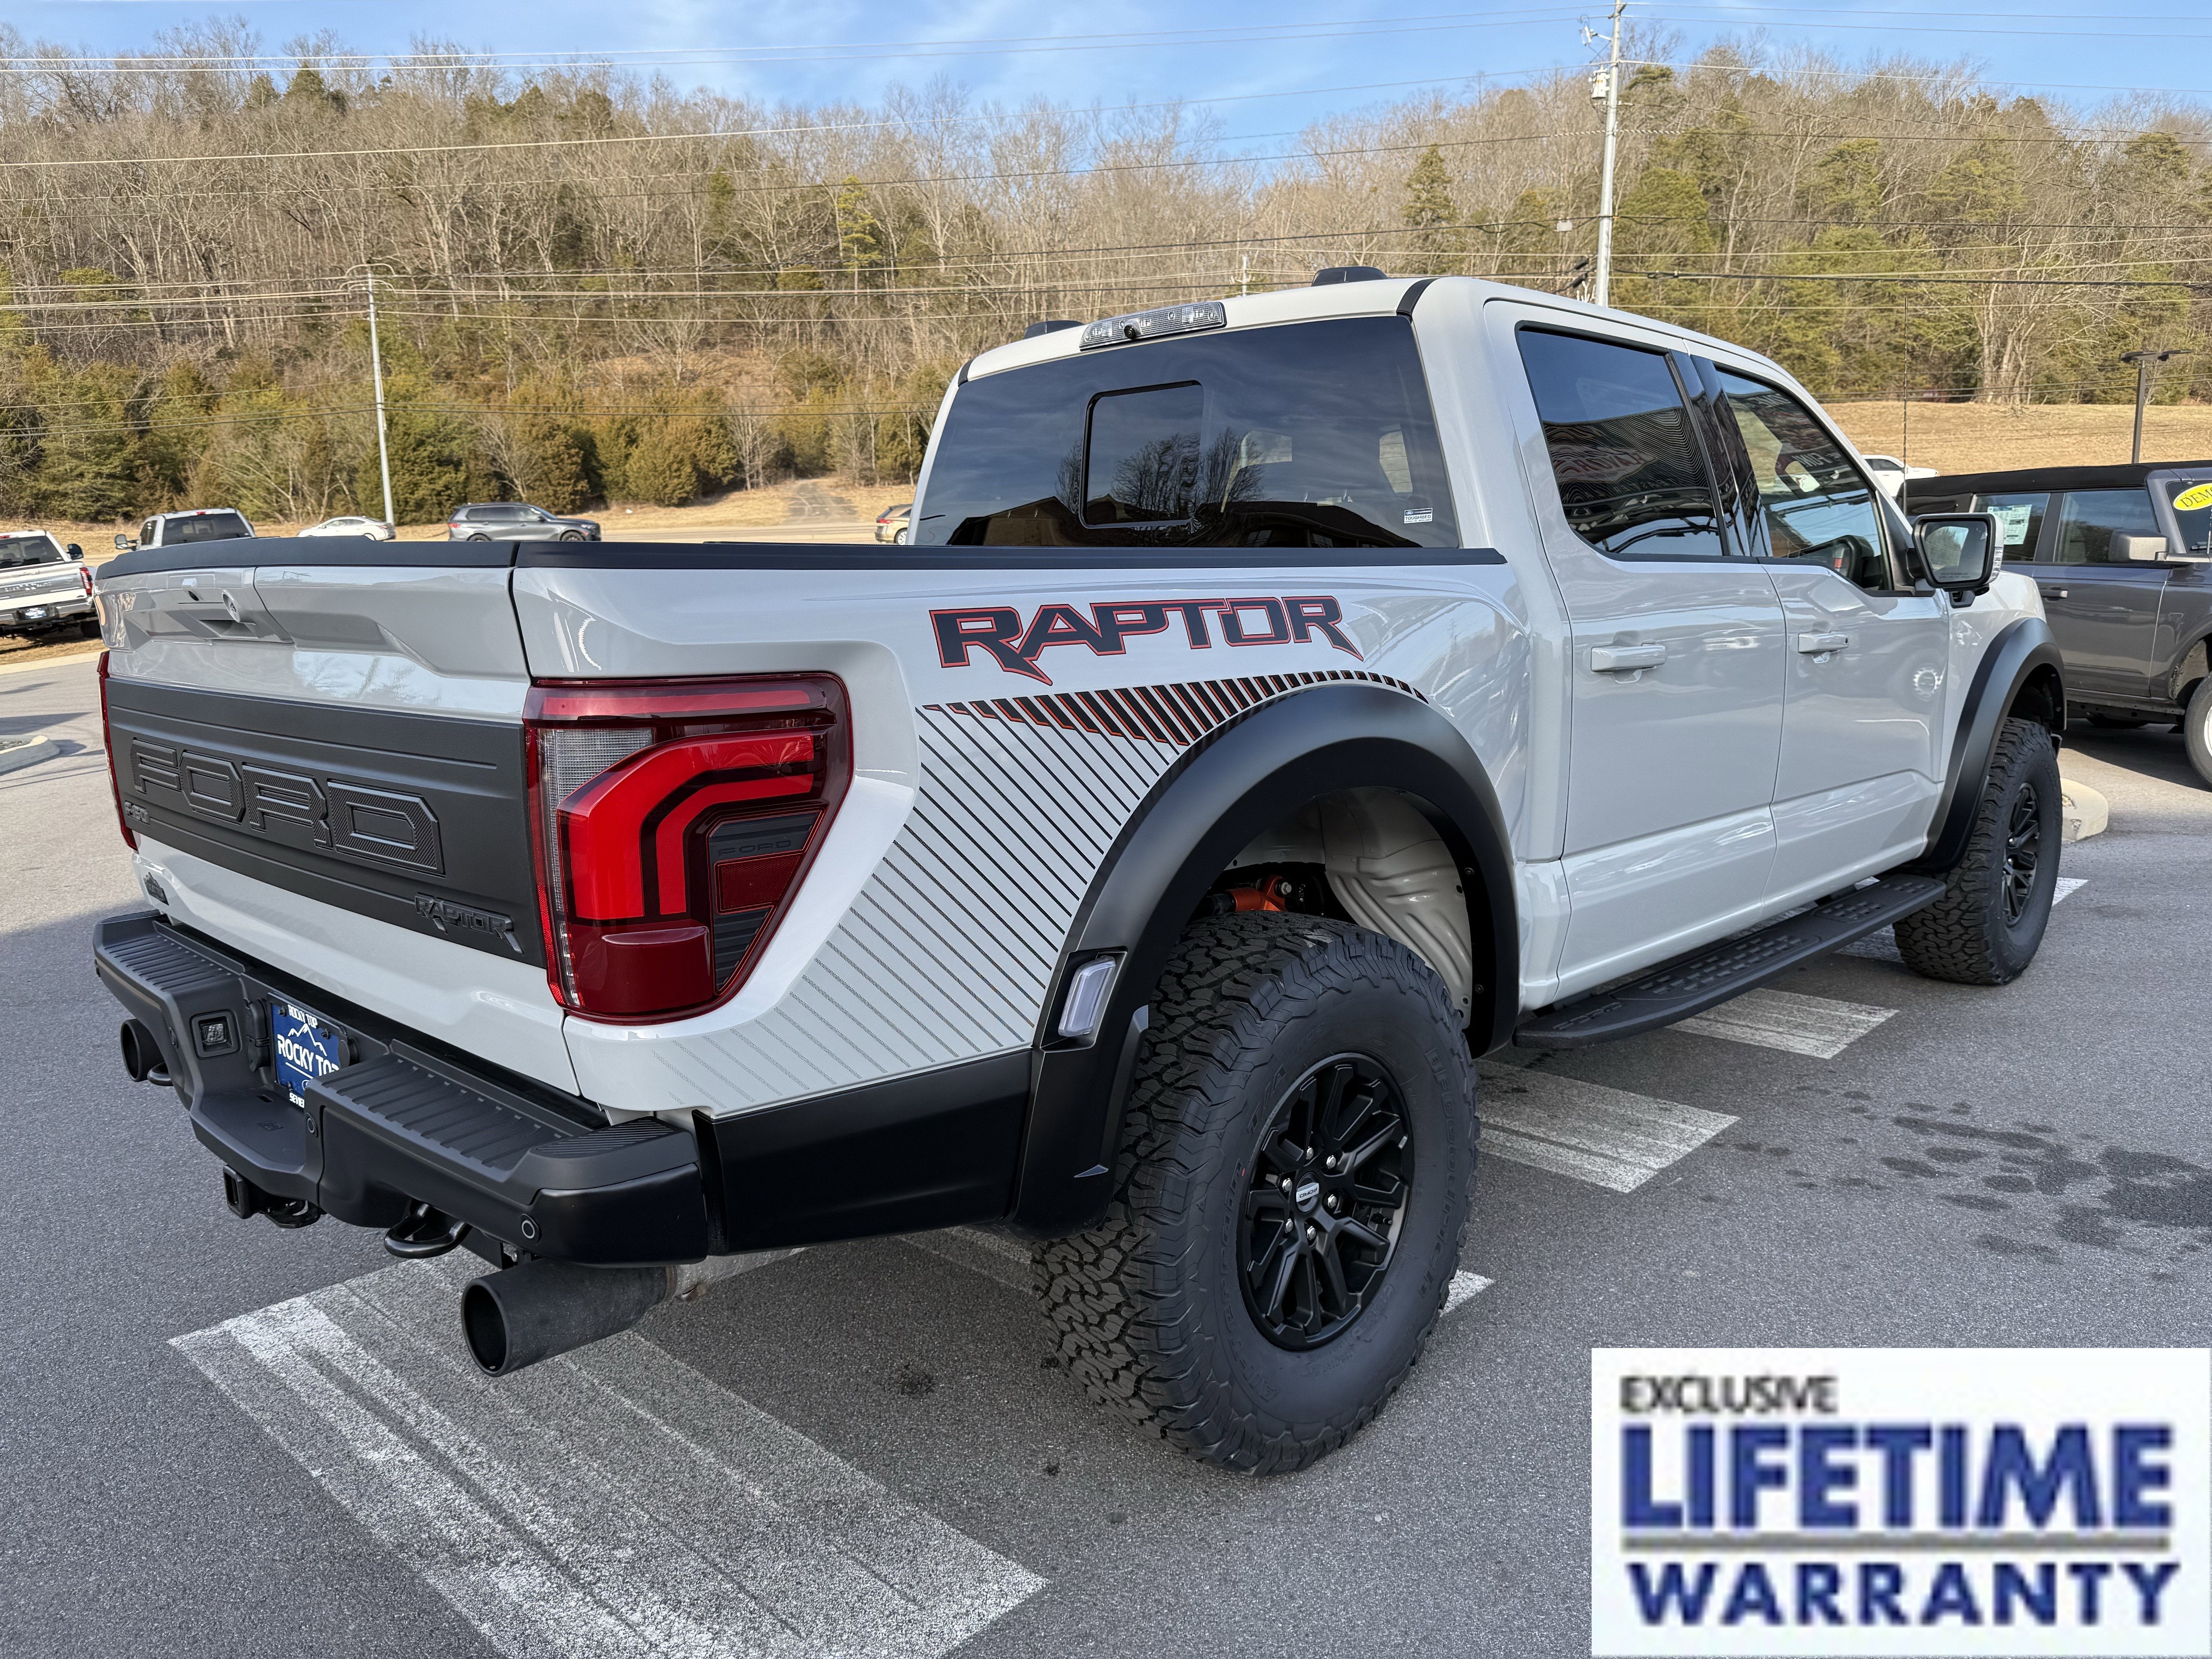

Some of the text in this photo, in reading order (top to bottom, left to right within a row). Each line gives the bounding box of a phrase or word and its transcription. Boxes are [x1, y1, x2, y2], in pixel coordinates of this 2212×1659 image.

[929, 596, 1364, 686] RAPTOR
[130, 737, 446, 878] FORD
[718, 840, 792, 856] FORD
[415, 892, 525, 955] RAPTOR
[277, 1034, 314, 1072] ROCKY
[1299, 1187, 1317, 1198] FORD
